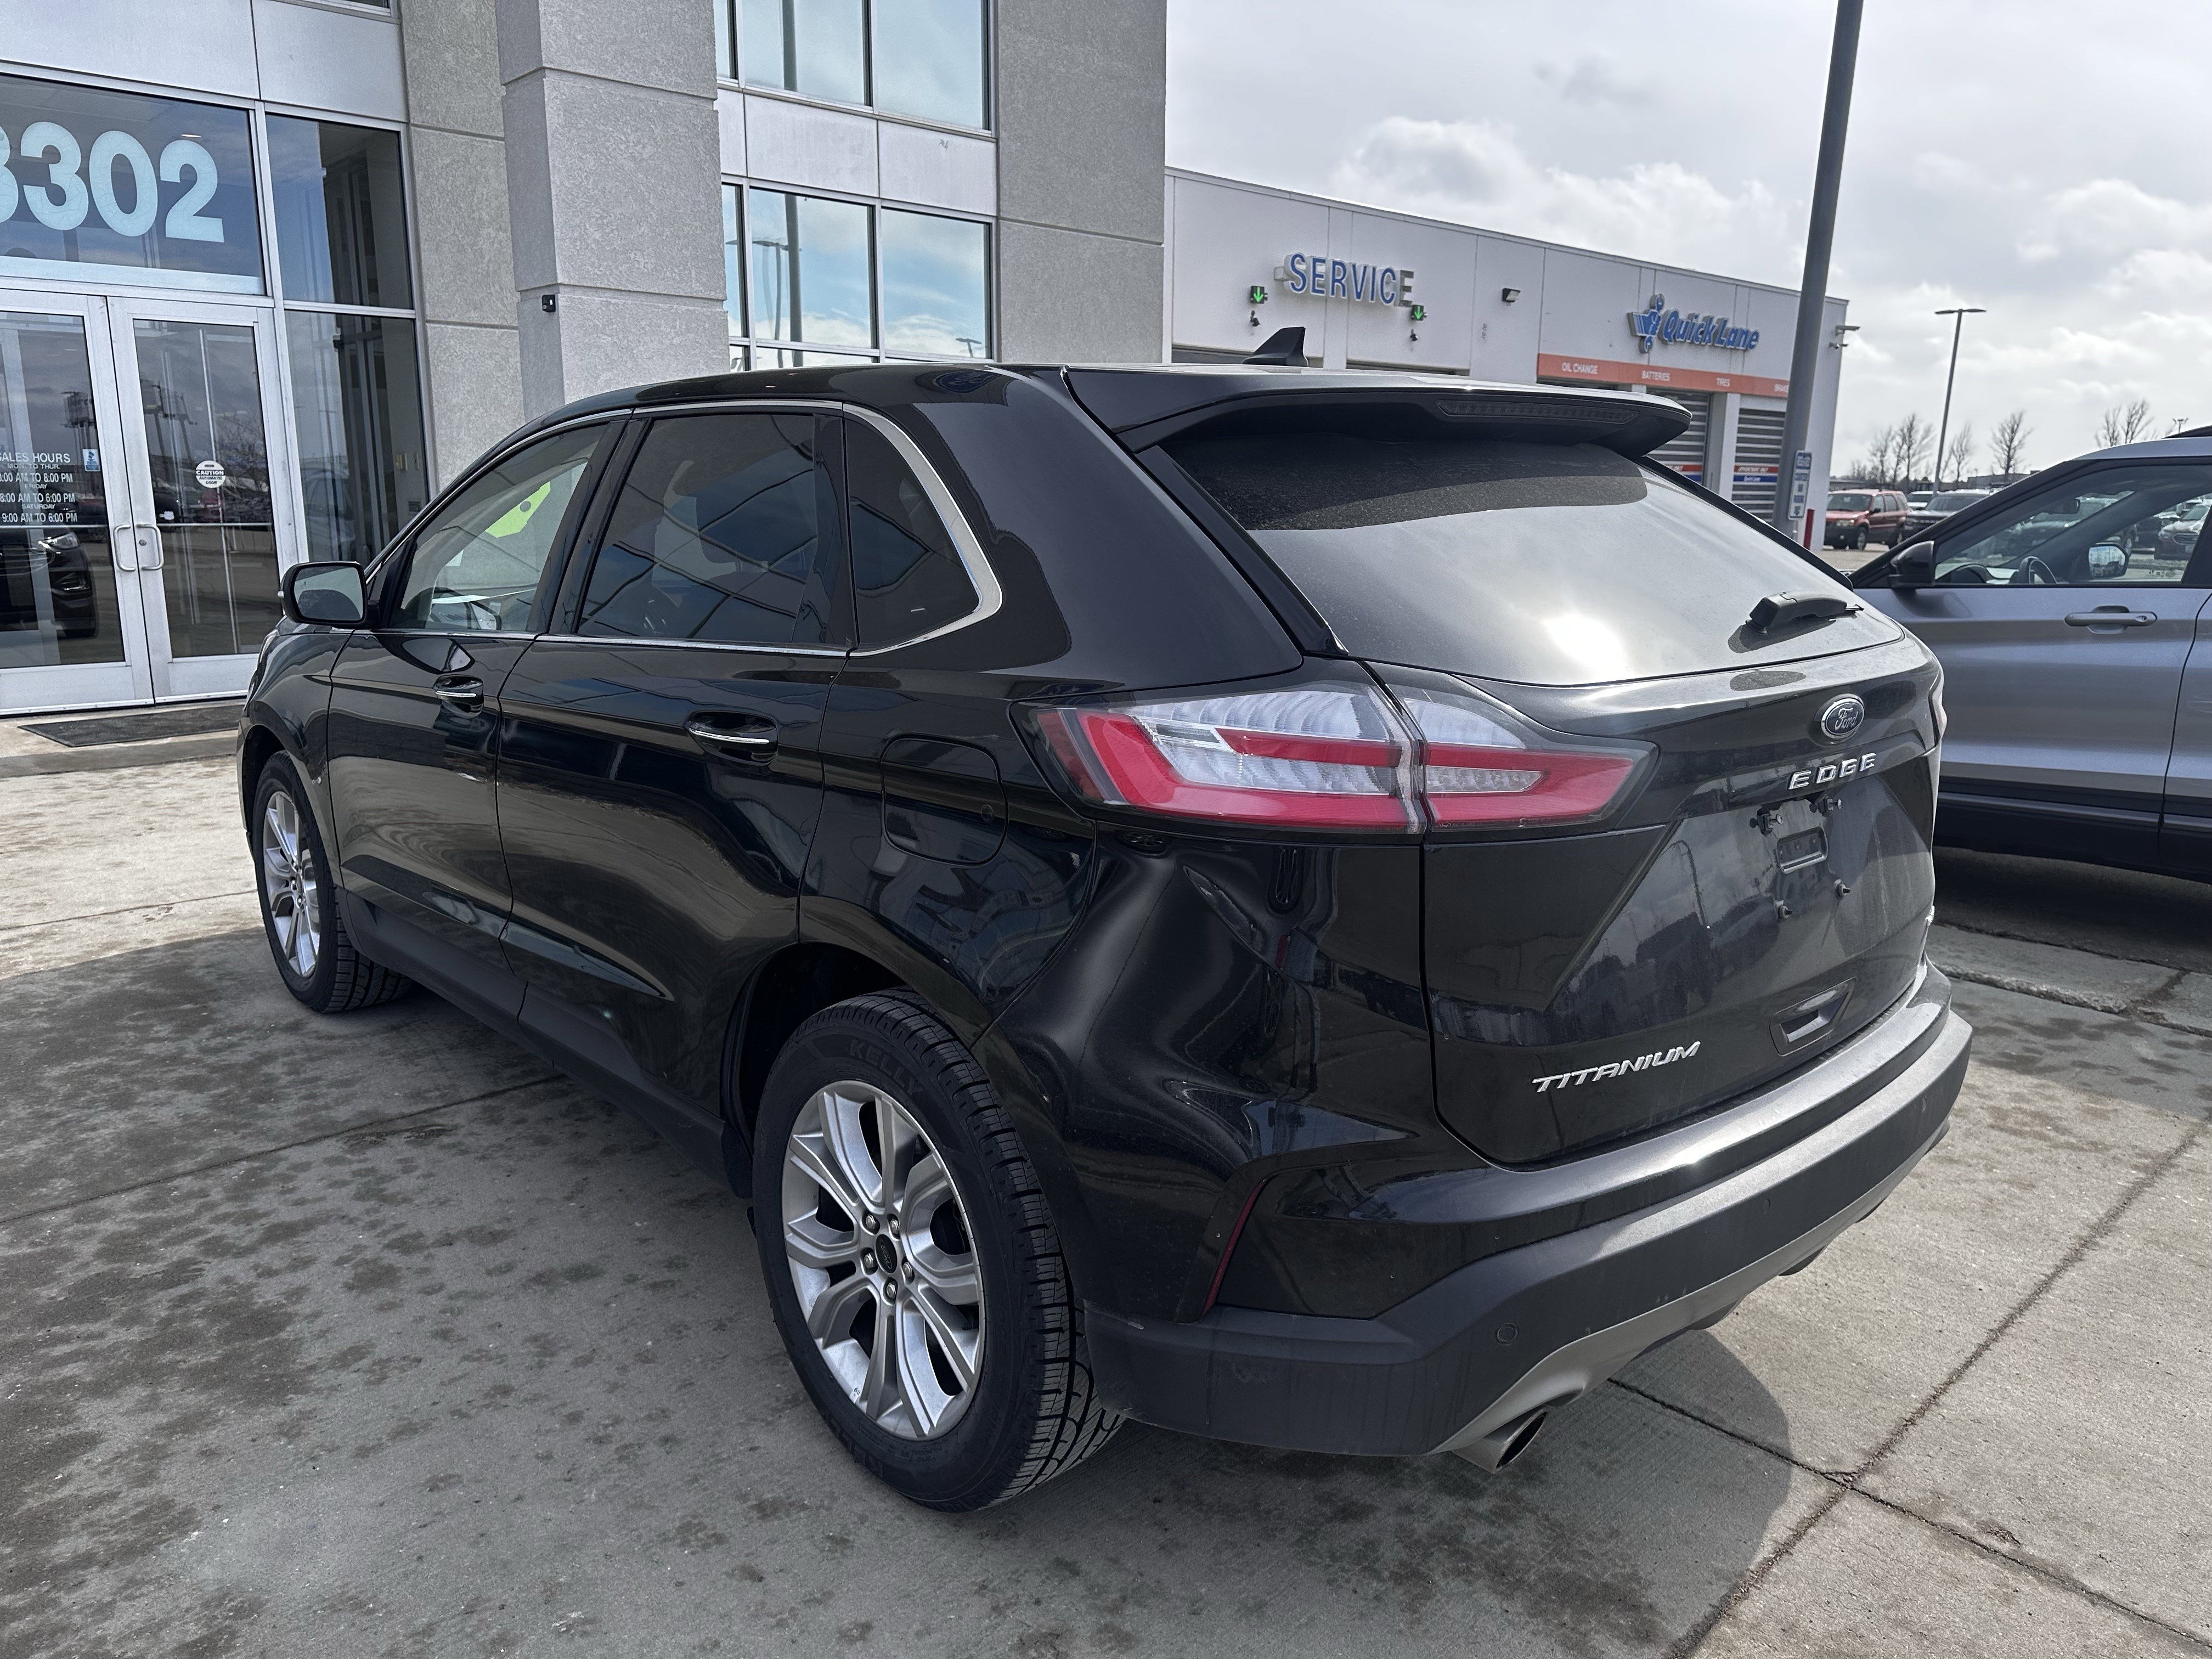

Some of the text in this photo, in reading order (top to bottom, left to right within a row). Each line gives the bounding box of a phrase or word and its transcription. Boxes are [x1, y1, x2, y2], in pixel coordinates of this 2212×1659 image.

[1286, 252, 1414, 307] SERVICE
[1662, 309, 1759, 351] Quick Lane
[1562, 362, 1598, 375] OIL CHANGE
[1641, 370, 1670, 381] BATTERIES
[33, 452, 71, 463] HOURS
[16, 472, 29, 482] AM
[30, 472, 41, 483] TO
[44, 472, 59, 483] 8:00
[61, 473, 73, 483] PM
[0, 493, 75, 503] 8:00 AM TO 6:00 PM
[2, 512, 78, 523] 9:00 AM TO 6:00 PM
[1835, 707, 1859, 730] Ford
[1788, 752, 1876, 790] EDGE
[850, 1039, 924, 1096] KELLY
[1532, 1041, 1701, 1092] TITANIUM
